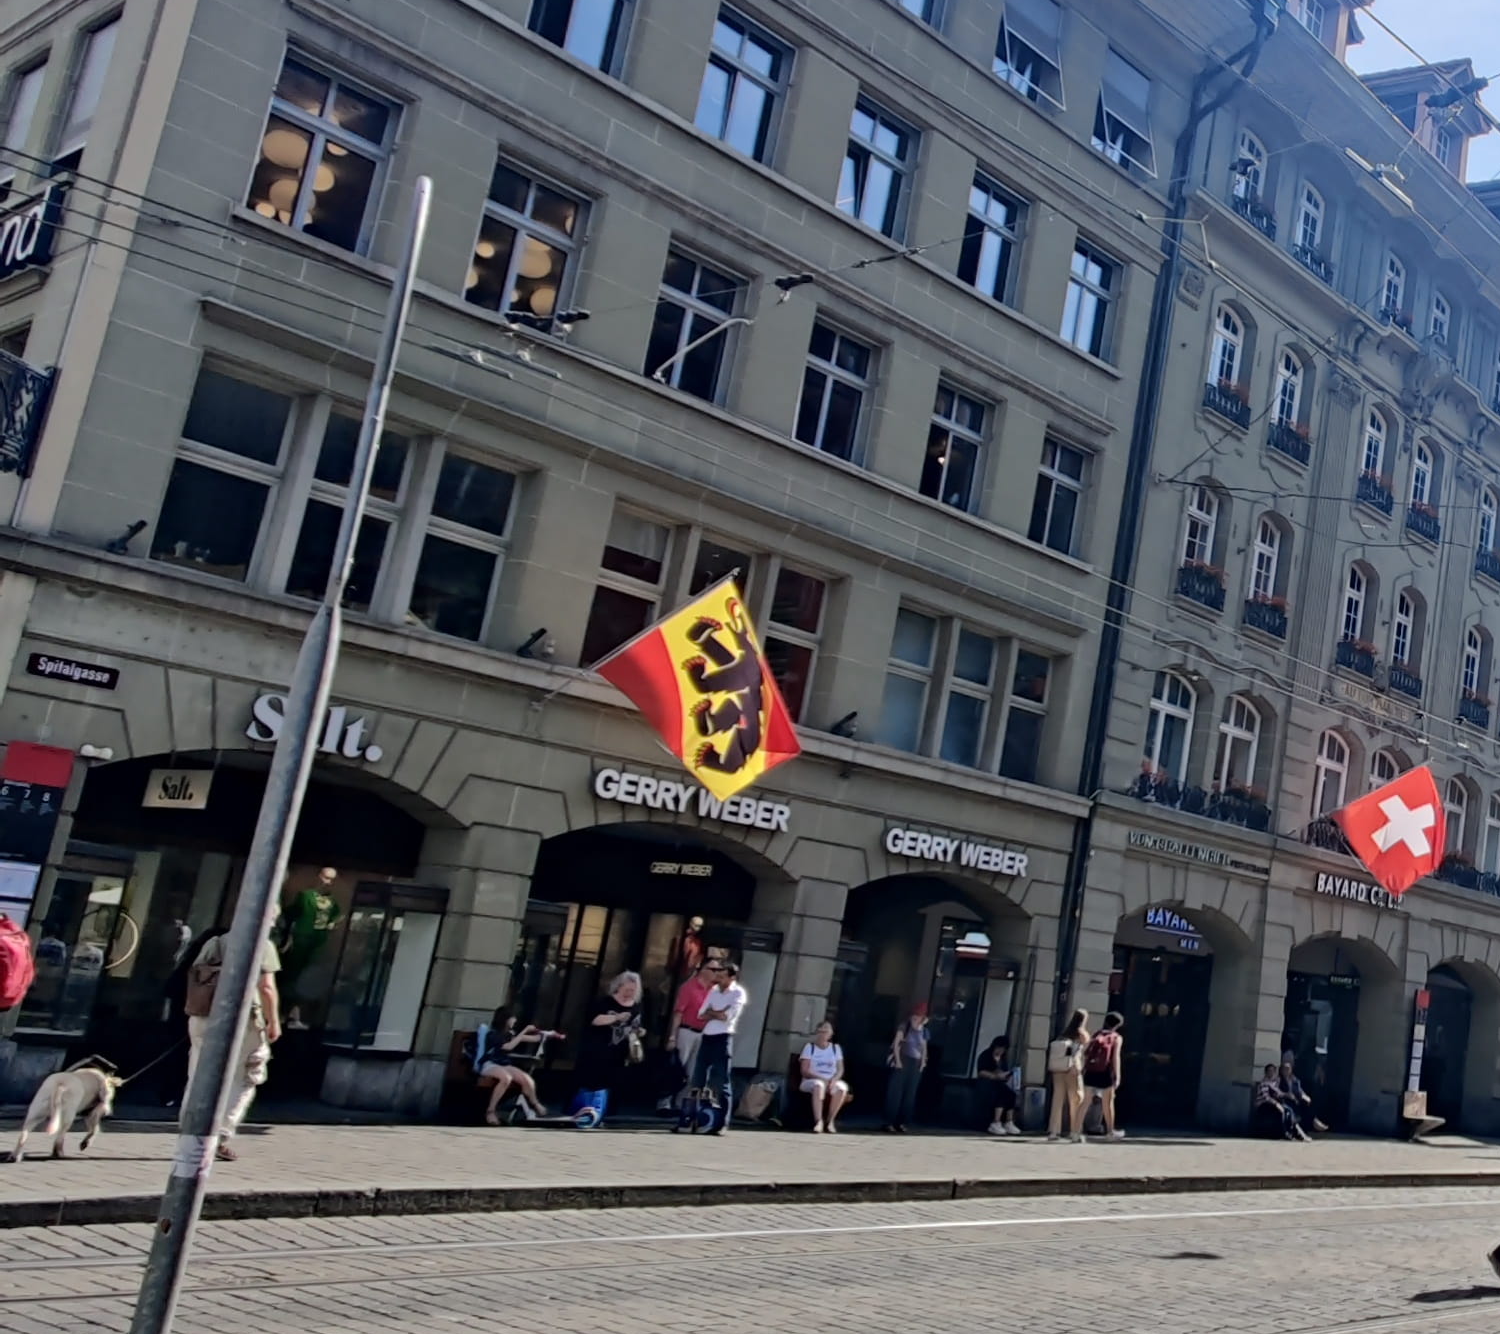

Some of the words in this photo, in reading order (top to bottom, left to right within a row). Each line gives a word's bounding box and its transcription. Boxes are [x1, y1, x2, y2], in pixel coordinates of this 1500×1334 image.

[37, 656, 110, 683] Spitalgasse
[246, 693, 383, 762] Slt.
[1, 785, 9, 795] 6
[23, 789, 31, 799] 7
[42, 792, 50, 802] 8
[158, 775, 194, 802] Salt.
[594, 768, 696, 814] GERRY
[698, 787, 792, 833] WEBER
[886, 827, 959, 863] GERRY
[960, 841, 1028, 877] WEBER
[651, 861, 680, 874] GERRY
[681, 864, 712, 877] WEBER
[1317, 872, 1367, 902] BAYARD
[1146, 907, 1195, 931] BAYAR
